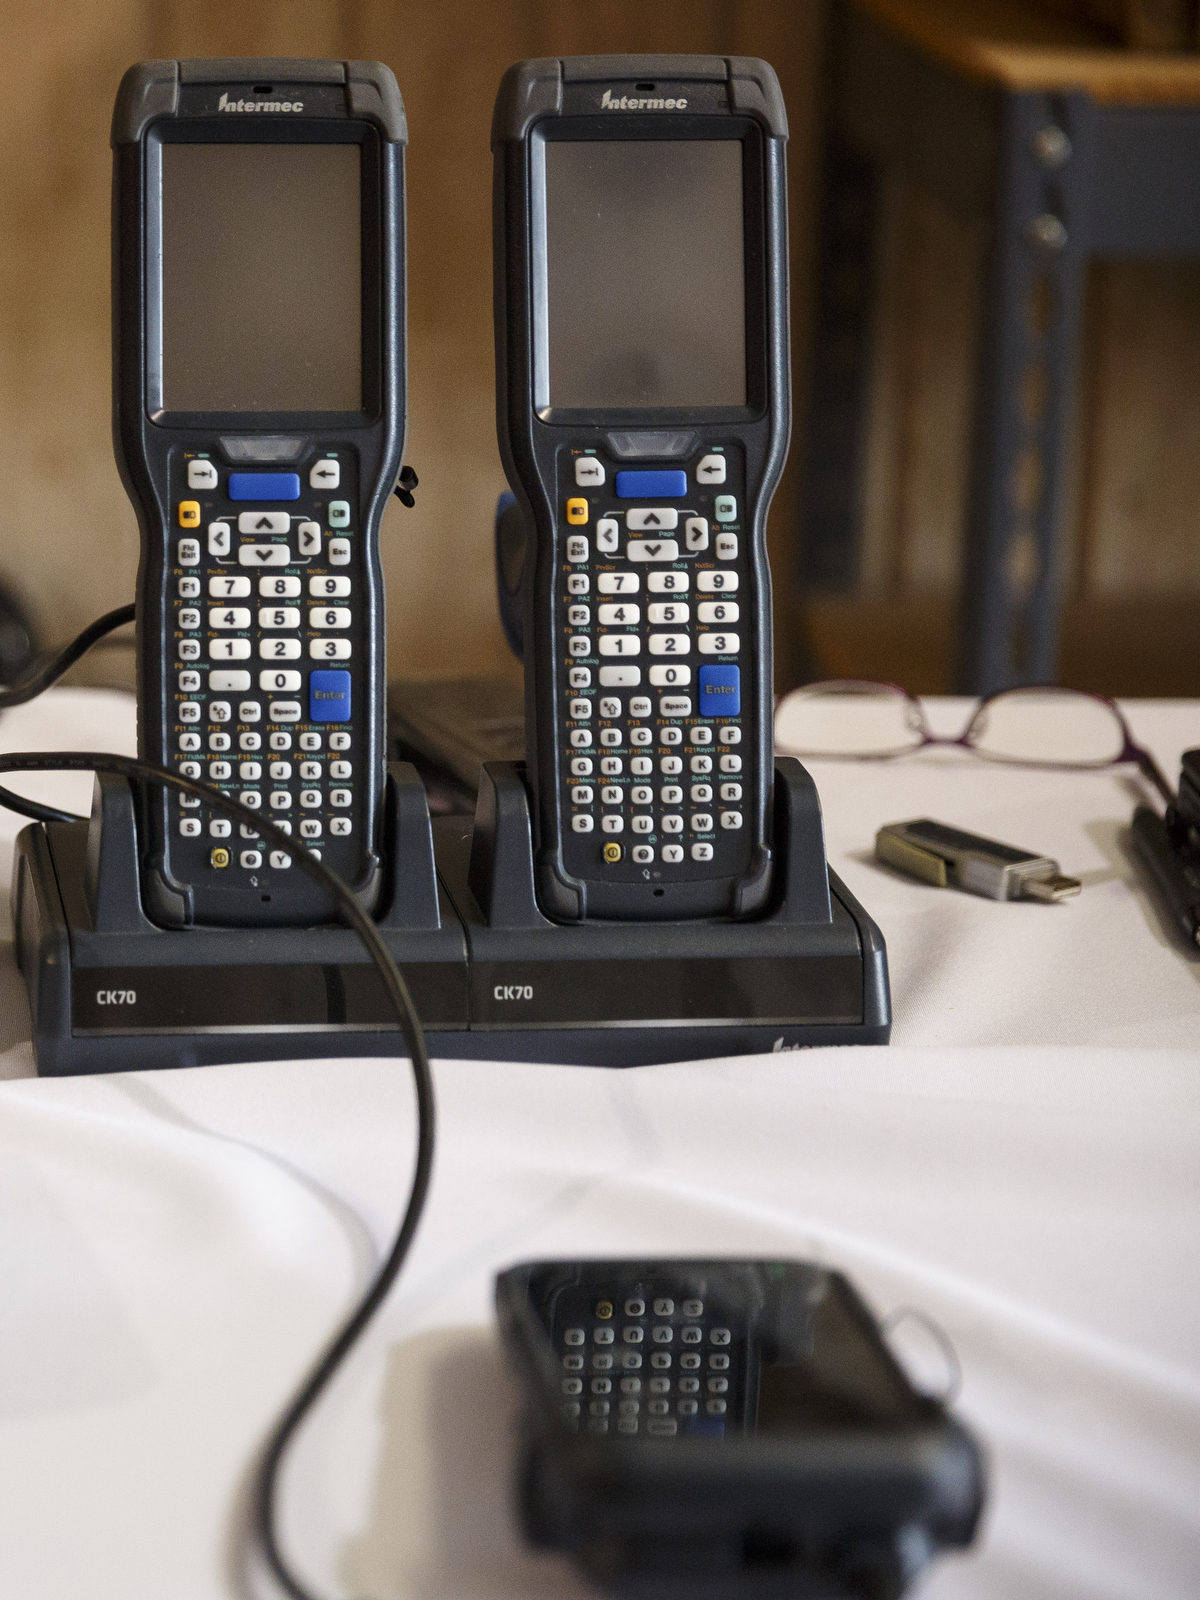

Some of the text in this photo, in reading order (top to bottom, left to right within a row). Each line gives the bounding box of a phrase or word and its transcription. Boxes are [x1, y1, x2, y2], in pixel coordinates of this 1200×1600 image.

[218, 92, 303, 113] Intermec
[601, 89, 687, 109] Intermec
[183, 583, 195, 592] F1
[225, 580, 235, 594] 7
[275, 580, 286, 594] 8
[325, 580, 336, 593] 9
[573, 580, 585, 588] F1
[614, 577, 624, 590] 7
[664, 575, 675, 589] 8
[713, 575, 724, 588] 9
[182, 614, 196, 623] F2
[224, 611, 235, 625] 4
[274, 611, 285, 625] 5
[326, 611, 336, 625] 6
[573, 611, 586, 620] F2
[614, 608, 625, 621] 4
[664, 607, 675, 621] 5
[715, 606, 725, 619] 6
[183, 646, 197, 654] F3
[225, 643, 233, 656] 1
[275, 642, 286, 656] 2
[325, 642, 337, 656] 3
[573, 642, 587, 651] F3
[615, 639, 623, 653] 1
[665, 638, 676, 652] 2
[715, 637, 726, 650] 3
[183, 677, 196, 685] F4
[275, 674, 286, 687] 0
[574, 673, 587, 682] F4
[665, 669, 676, 683] 0
[315, 690, 345, 699] Enter
[706, 685, 736, 694] Enter
[182, 708, 196, 717] F5
[274, 708, 297, 716] Space
[575, 705, 589, 713] F5
[96, 990, 137, 1005] CK70
[493, 985, 533, 1000] CK70
